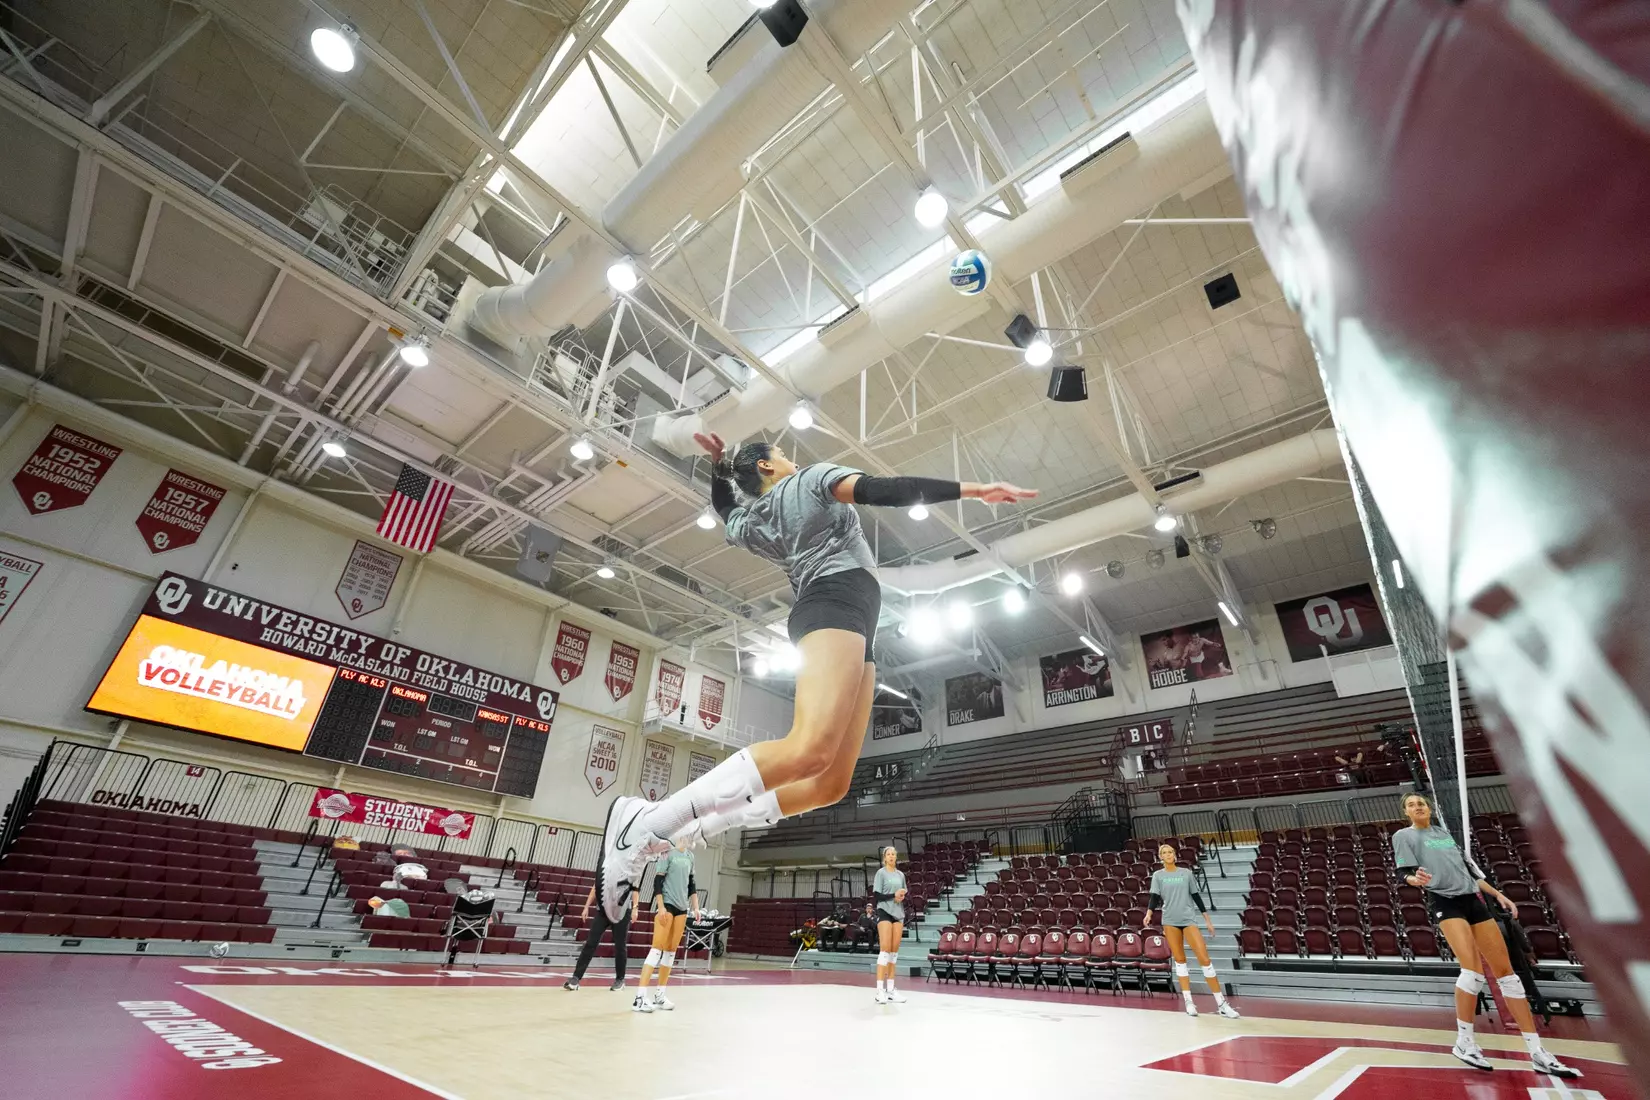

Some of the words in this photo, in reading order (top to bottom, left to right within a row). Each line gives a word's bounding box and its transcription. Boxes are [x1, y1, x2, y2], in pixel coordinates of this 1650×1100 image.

[53, 428, 118, 459] WRESTLING
[48, 443, 101, 473] 1952
[23, 464, 94, 494] CHAMPIONS
[30, 455, 98, 486] NATIONAL
[166, 471, 223, 500] WRESTLING
[163, 487, 210, 512] 1957
[144, 507, 204, 533] CHAMPIONS
[149, 498, 207, 525] NATIONAL
[351, 557, 395, 579] CHAMPIONS
[359, 552, 392, 570] NATIONAL
[561, 623, 590, 639] WRESTLING
[203, 588, 375, 655] UNIVERSITY
[380, 643, 411, 665] OF
[416, 653, 532, 703] OKLAHOMA
[555, 644, 585, 660] NATIONAL
[561, 634, 584, 651] 1960
[260, 627, 326, 656] HOWARD
[329, 648, 410, 682] McCASLAND
[411, 671, 448, 691] FIELD
[449, 680, 488, 703] HOUSE
[553, 651, 584, 666] CHAMPIONS
[613, 653, 634, 669] 1963
[149, 645, 304, 696] OKLAHOMA
[340, 669, 357, 680] PLY
[370, 678, 386, 688] KLS
[608, 663, 635, 677] NATIONAL
[662, 672, 681, 685] 1974
[1151, 668, 1188, 688] HODGE
[144, 662, 296, 715] VOLLEYBALL
[392, 686, 428, 702] OKLAHOMA
[1046, 685, 1098, 707] ARRINGTON
[381, 719, 396, 728] WON
[431, 718, 452, 728] PERIOD
[515, 717, 527, 726] PLY
[949, 709, 975, 725] DRAKE
[875, 723, 900, 739] CONNER
[1129, 728, 1140, 743] B
[1153, 724, 1163, 739] C
[593, 747, 611, 758] SWEET
[598, 740, 616, 752] NCAA
[590, 755, 616, 772] 2010
[651, 751, 667, 761] NCAA
[91, 789, 200, 817] OKLAHOMA
[364, 799, 434, 820] STUDENT
[363, 812, 428, 832] SECTION
[142, 1018, 268, 1057] SOONER
